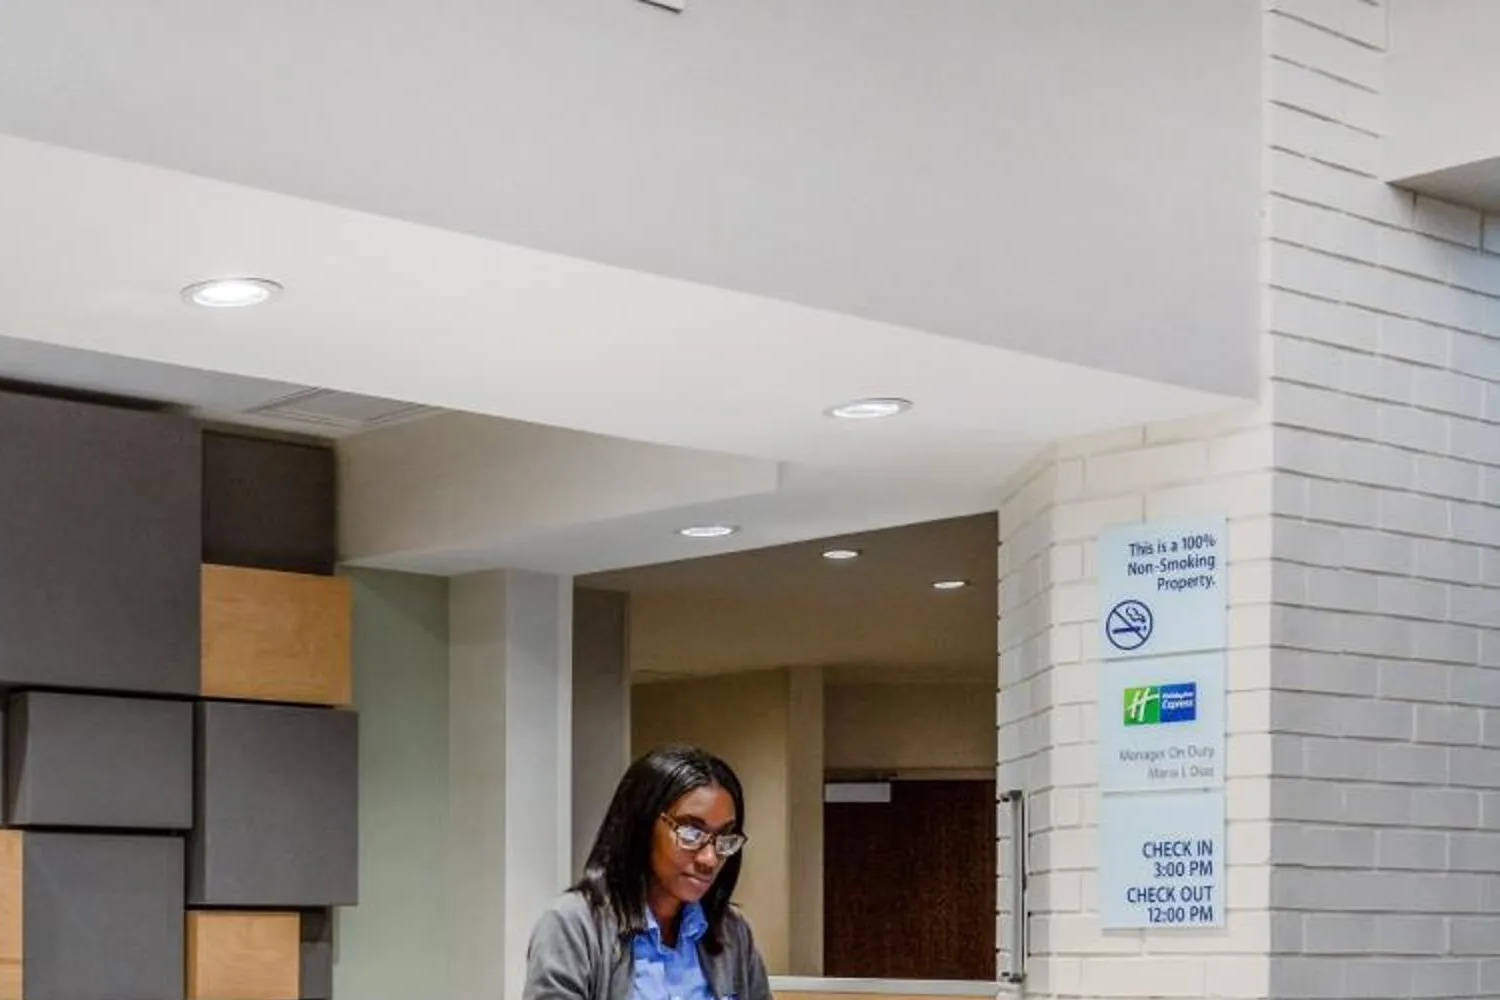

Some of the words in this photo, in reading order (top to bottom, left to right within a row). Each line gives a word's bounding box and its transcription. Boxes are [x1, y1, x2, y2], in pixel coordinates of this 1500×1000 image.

[1128, 542, 1154, 557] This
[1157, 539, 1167, 553] is
[1170, 541, 1179, 552] a
[1181, 534, 1217, 550] 100%
[1127, 554, 1216, 576] Non-Smoking
[1157, 576, 1217, 591] Property.
[1167, 746, 1186, 759] On
[1187, 744, 1215, 759] Duty
[1143, 840, 1193, 859] CHECK
[1197, 839, 1213, 857] IN
[1154, 861, 1185, 878] 3:00
[1189, 860, 1213, 877] PM
[1127, 886, 1176, 903] CHECK
[1180, 885, 1214, 902] OUT
[1148, 906, 1185, 923] 12:00
[1189, 905, 1213, 922] PM
